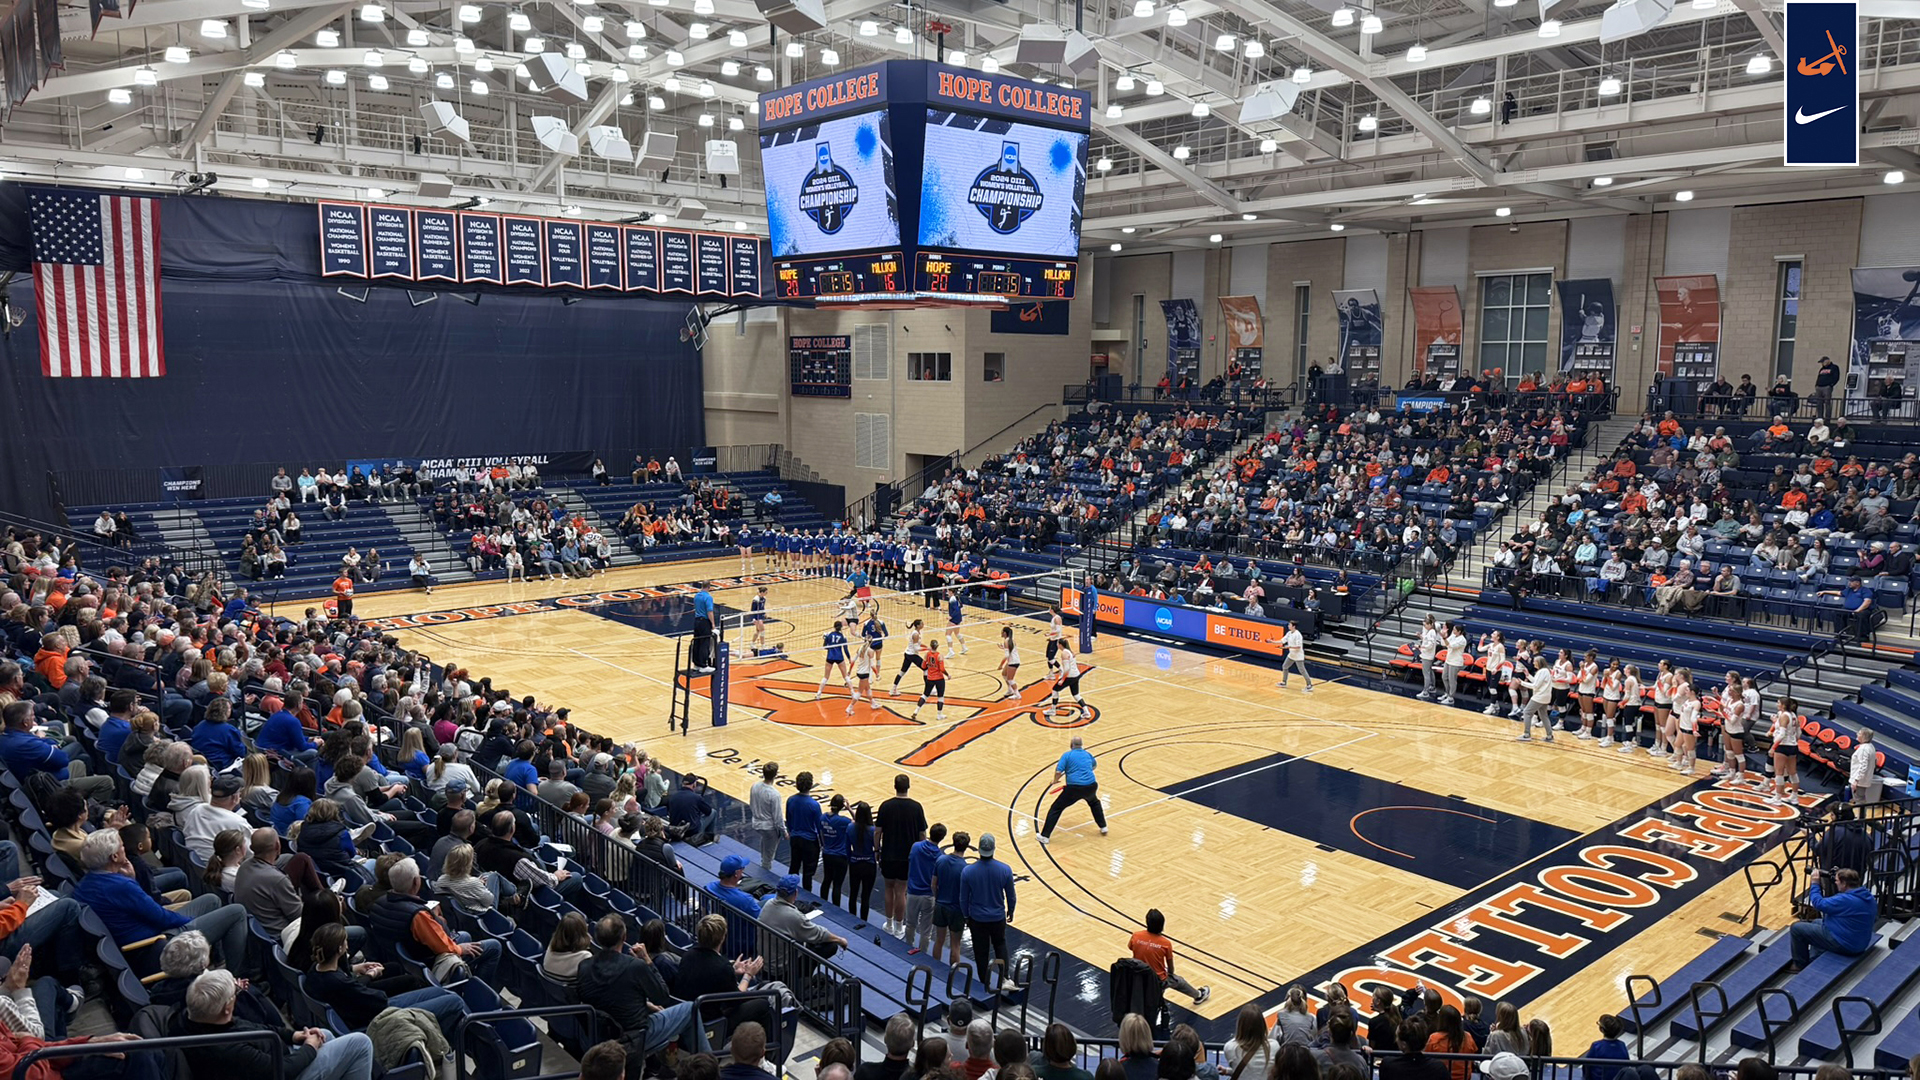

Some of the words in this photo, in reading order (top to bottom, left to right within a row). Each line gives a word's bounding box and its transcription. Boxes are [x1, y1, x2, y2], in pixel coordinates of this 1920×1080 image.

[765, 92, 802, 121] HOPE
[807, 72, 878, 111] COLLEGE
[938, 72, 992, 104] HOPE
[998, 84, 1082, 120] COLLEGE
[980, 180, 1004, 189] WOMEN'S
[1005, 183, 1034, 192] VOLLEYBALL
[990, 175, 1009, 183] 2024
[800, 188, 857, 208] CHAMPIONSHIP
[970, 188, 1042, 208] CHAMPIONSHIP
[330, 211, 354, 219] NCAA
[780, 269, 798, 280] HOPE
[926, 261, 952, 273] HOPE
[787, 280, 799, 296] 20
[884, 274, 895, 291] 16
[931, 274, 948, 291] 20
[1053, 281, 1065, 296] 16
[793, 338, 811, 348] HOPE
[813, 338, 846, 348] COLLEGE
[422, 458, 453, 468] NCAA
[364, 601, 556, 630] HOPE
[1214, 624, 1226, 636] BE
[832, 635, 841, 643] 17
[1615, 770, 1832, 862] HOPE
[1263, 843, 1699, 1042] COLLEG
